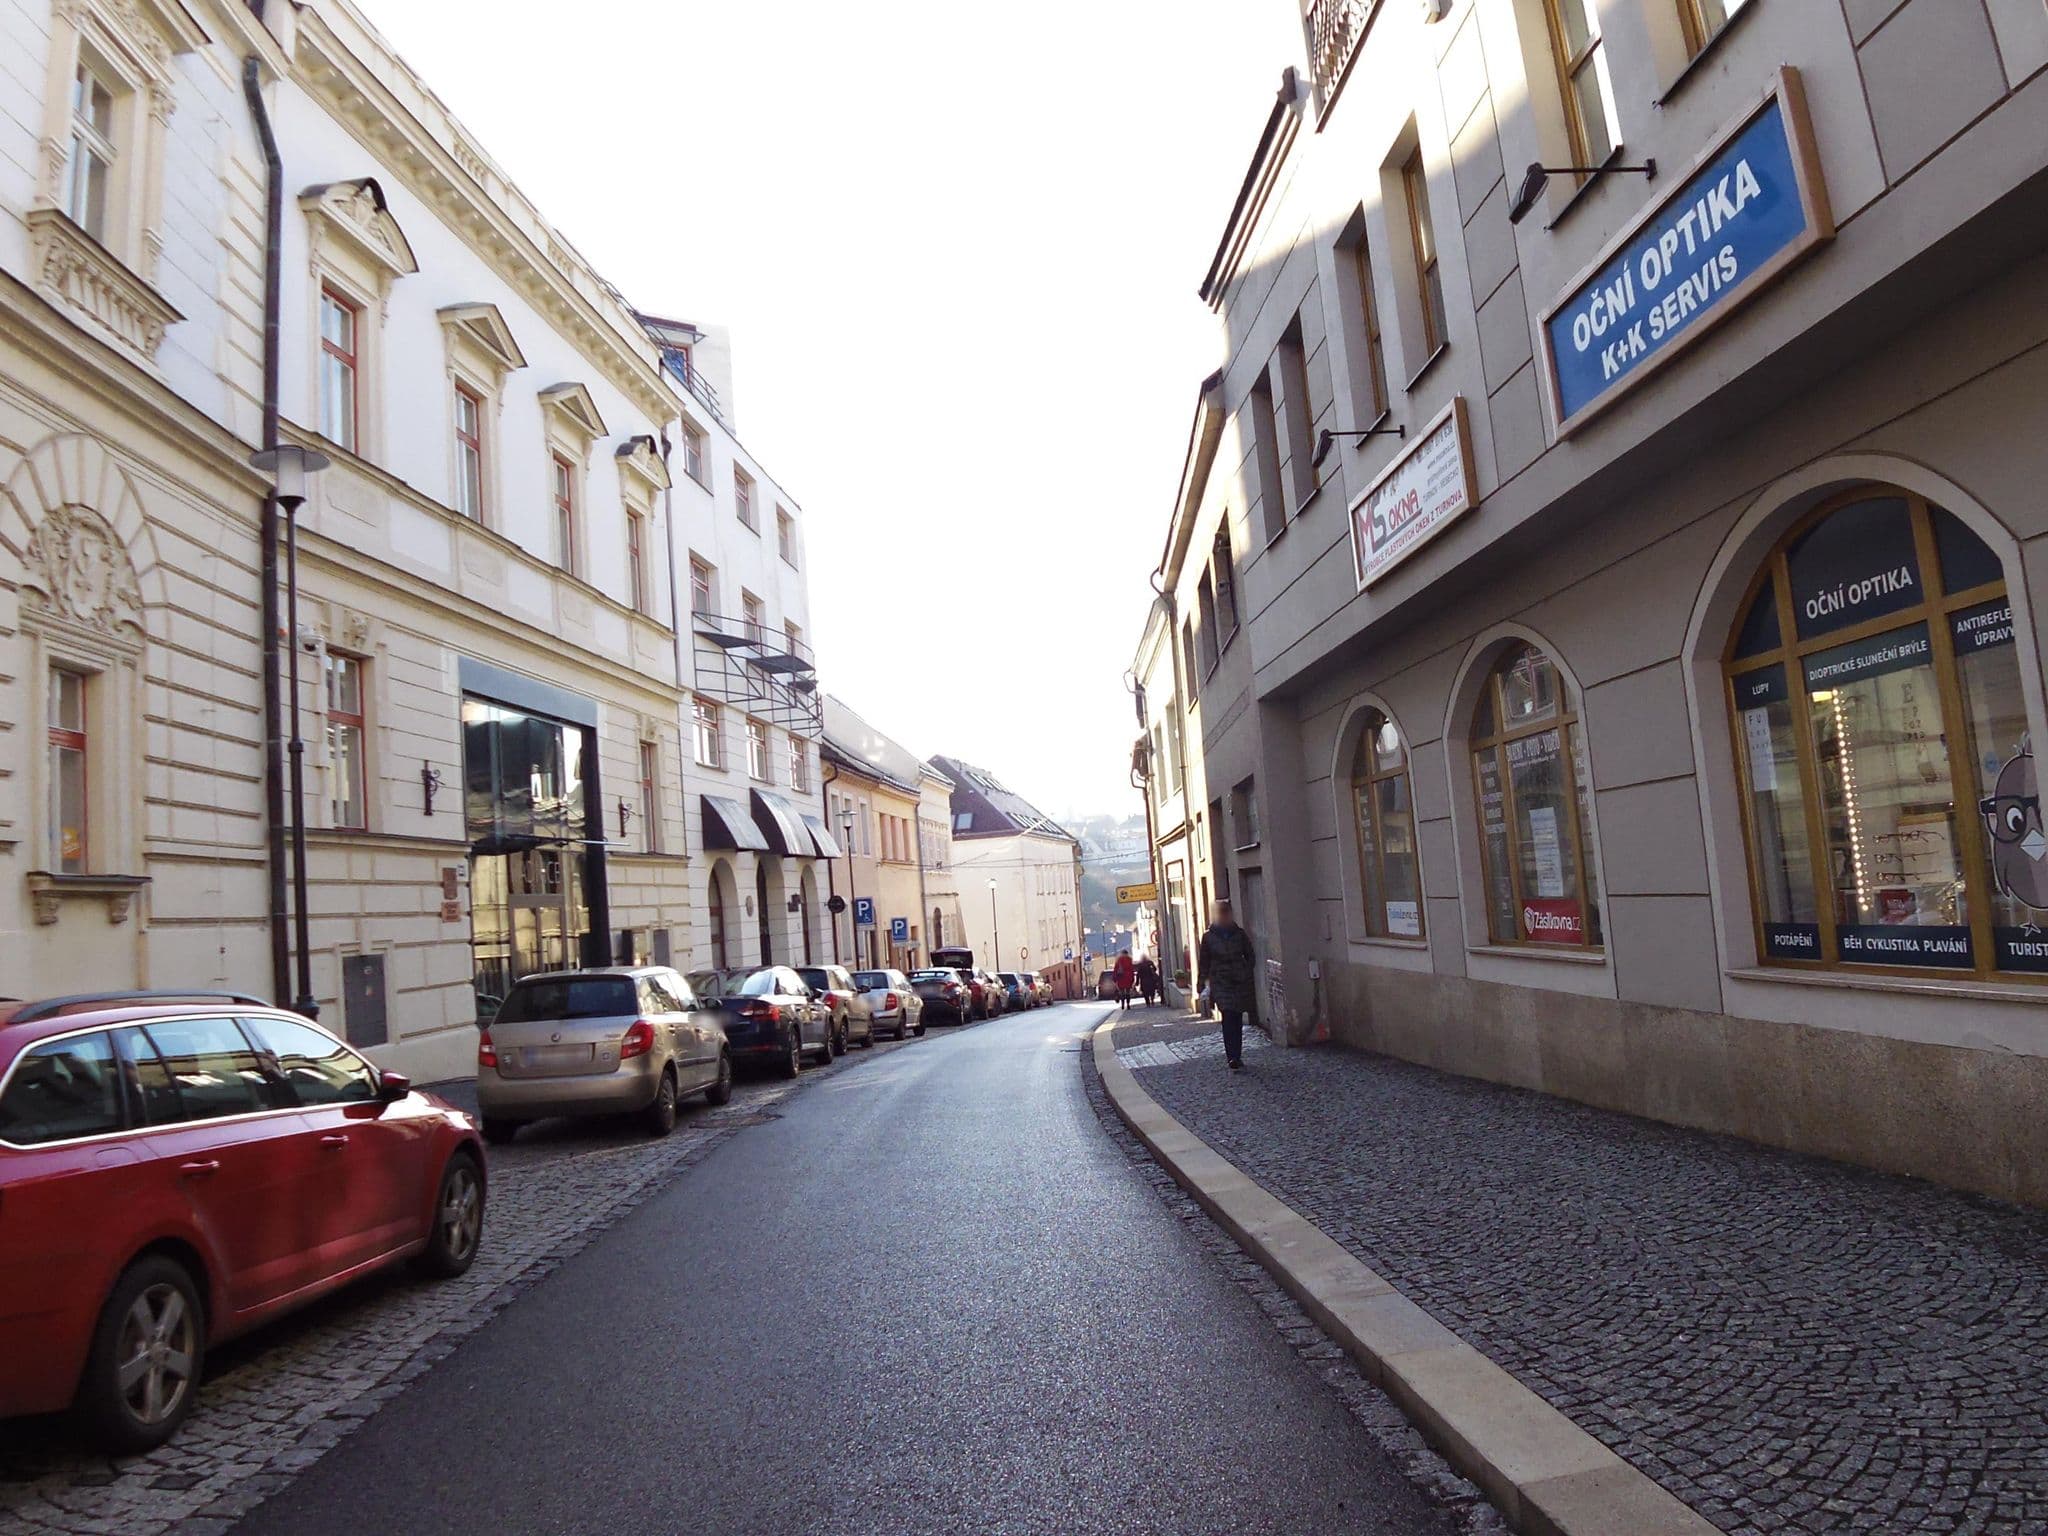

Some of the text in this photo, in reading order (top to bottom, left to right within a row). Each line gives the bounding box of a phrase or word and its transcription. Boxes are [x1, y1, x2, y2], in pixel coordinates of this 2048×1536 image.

[1572, 158, 1761, 352] OČNÍ OPTIKA
[1601, 244, 1738, 381] K+K SERVIS
[1388, 488, 1420, 530] OKNA
[1435, 489, 1463, 517] TURNOVA
[1806, 566, 1913, 619] OČNÍ OPTIKA
[1974, 625, 2015, 646] ÚPRAVY
[1809, 639, 1929, 681] DIOPTRICKÉ SLUNEČNÍ BRÝLE
[1752, 682, 1769, 696] LUPY
[858, 900, 870, 917] P
[894, 920, 905, 935] P
[1774, 932, 1813, 948] POTÁPĚNÍ
[1843, 934, 1863, 950] BĚH
[1866, 938, 1920, 952] CYKLISTIKA
[1924, 938, 1967, 954] PLAVÁNÍ
